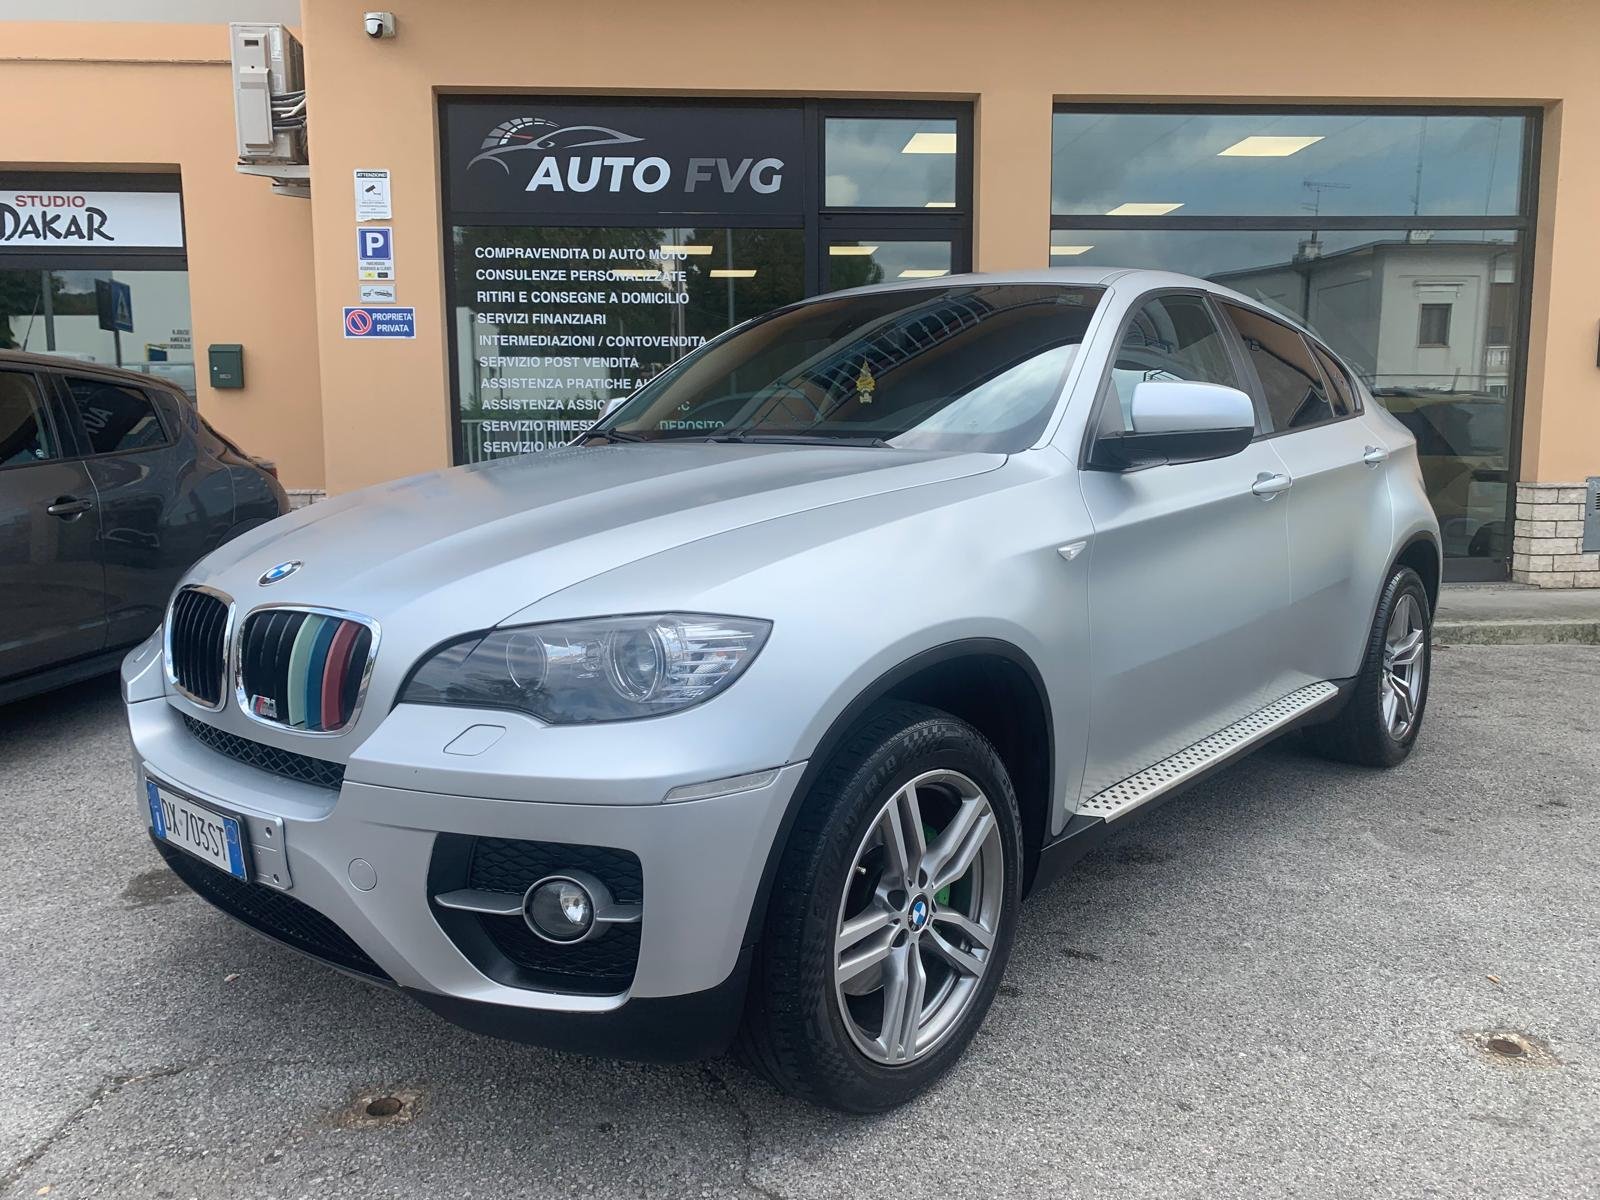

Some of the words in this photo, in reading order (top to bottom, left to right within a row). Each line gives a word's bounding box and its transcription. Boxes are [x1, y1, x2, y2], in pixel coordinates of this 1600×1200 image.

[525, 156, 671, 193] AUTO
[683, 157, 785, 194] FVG
[15, 195, 86, 208] STUDIO
[0, 202, 115, 241] DAKAR
[365, 232, 384, 256] P
[475, 247, 589, 260] COMPRAVENDITA
[592, 249, 606, 260] DI
[608, 249, 646, 260] AUTO
[649, 249, 688, 261] MOTO
[475, 269, 567, 281] CONSULENZE
[570, 270, 687, 282] PERSONALIZZATE
[477, 291, 515, 303] RITIRI
[519, 291, 527, 303] E
[531, 291, 606, 304] CONSEGNE
[609, 291, 618, 303] A
[621, 292, 690, 304] DOMICILIO
[477, 312, 529, 325] SERVIZI
[532, 314, 607, 325] FINANZIARI
[376, 324, 409, 332] PRIVATA
[479, 335, 595, 347] INTERMEDIAZIONI
[606, 336, 707, 347] CONTOVENDITA
[480, 356, 541, 368] SERVIZIO
[544, 357, 579, 368] POST
[583, 357, 640, 368] VENDITA
[481, 378, 563, 389] ASSISTENZA
[567, 378, 631, 389] PRATICHE
[482, 399, 563, 411] ASSISTENZA
[482, 420, 543, 432] SERVIZIO
[483, 441, 544, 453] SERVIZIO
